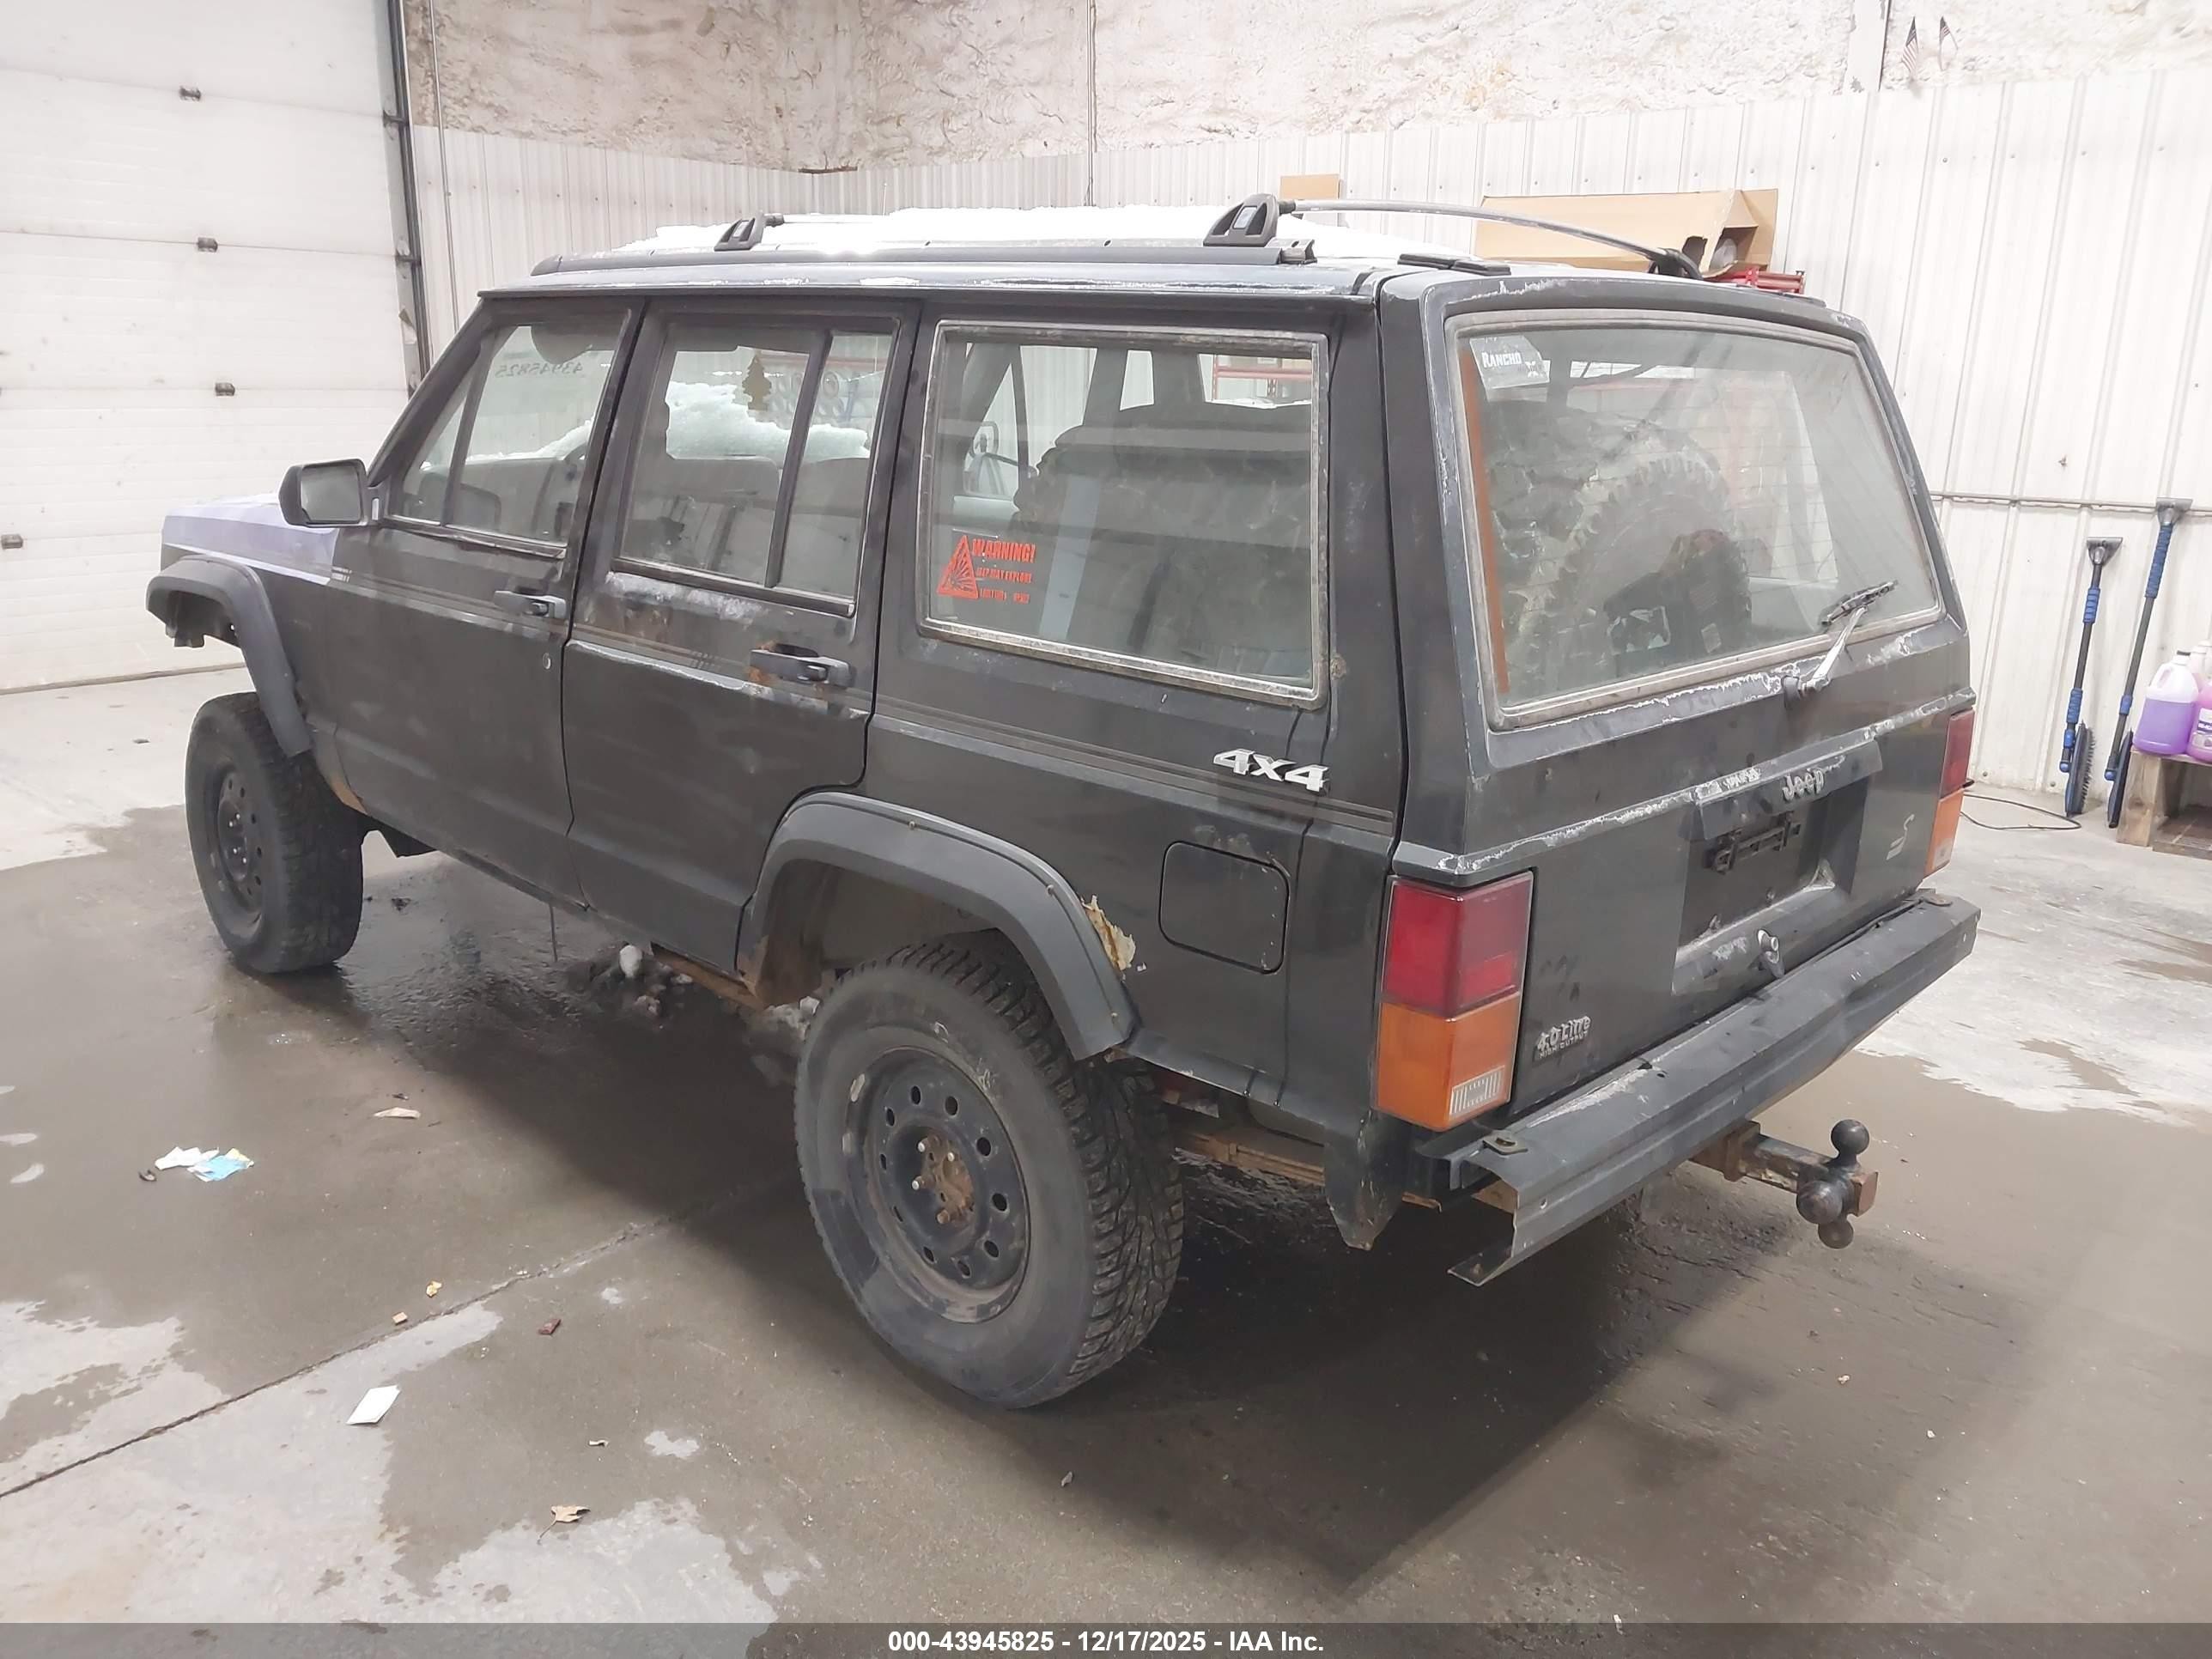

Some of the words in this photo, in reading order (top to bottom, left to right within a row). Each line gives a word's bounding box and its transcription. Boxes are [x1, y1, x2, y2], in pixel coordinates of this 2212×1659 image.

[1481, 352, 1522, 368] RANCHO
[972, 538, 1036, 563] WARNING!
[1783, 768, 1825, 800] Jeep
[1560, 1030, 1589, 1049] OUTPUT
